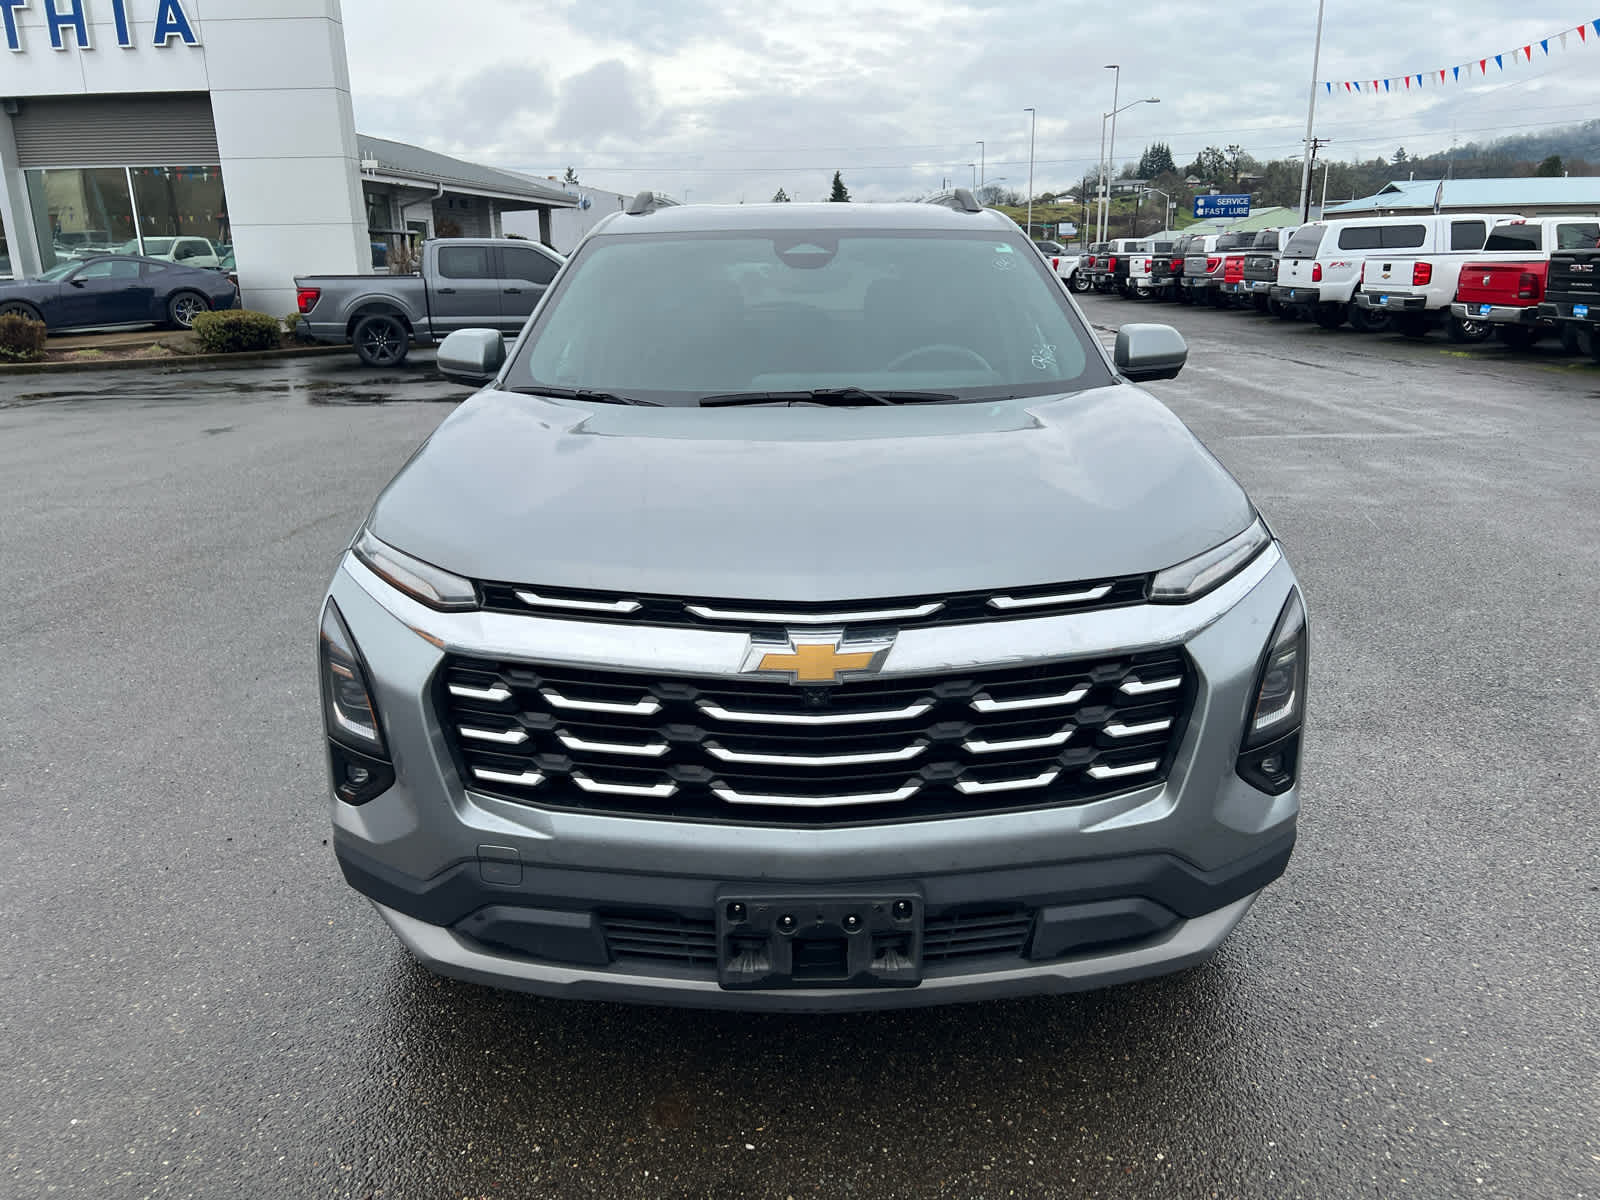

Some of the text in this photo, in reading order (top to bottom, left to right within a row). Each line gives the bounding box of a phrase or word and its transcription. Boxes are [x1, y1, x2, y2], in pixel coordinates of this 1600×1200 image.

[1216, 198, 1249, 206] SERVICE
[1204, 207, 1249, 215] FAST LUBE
[1569, 264, 1594, 272] GMC
